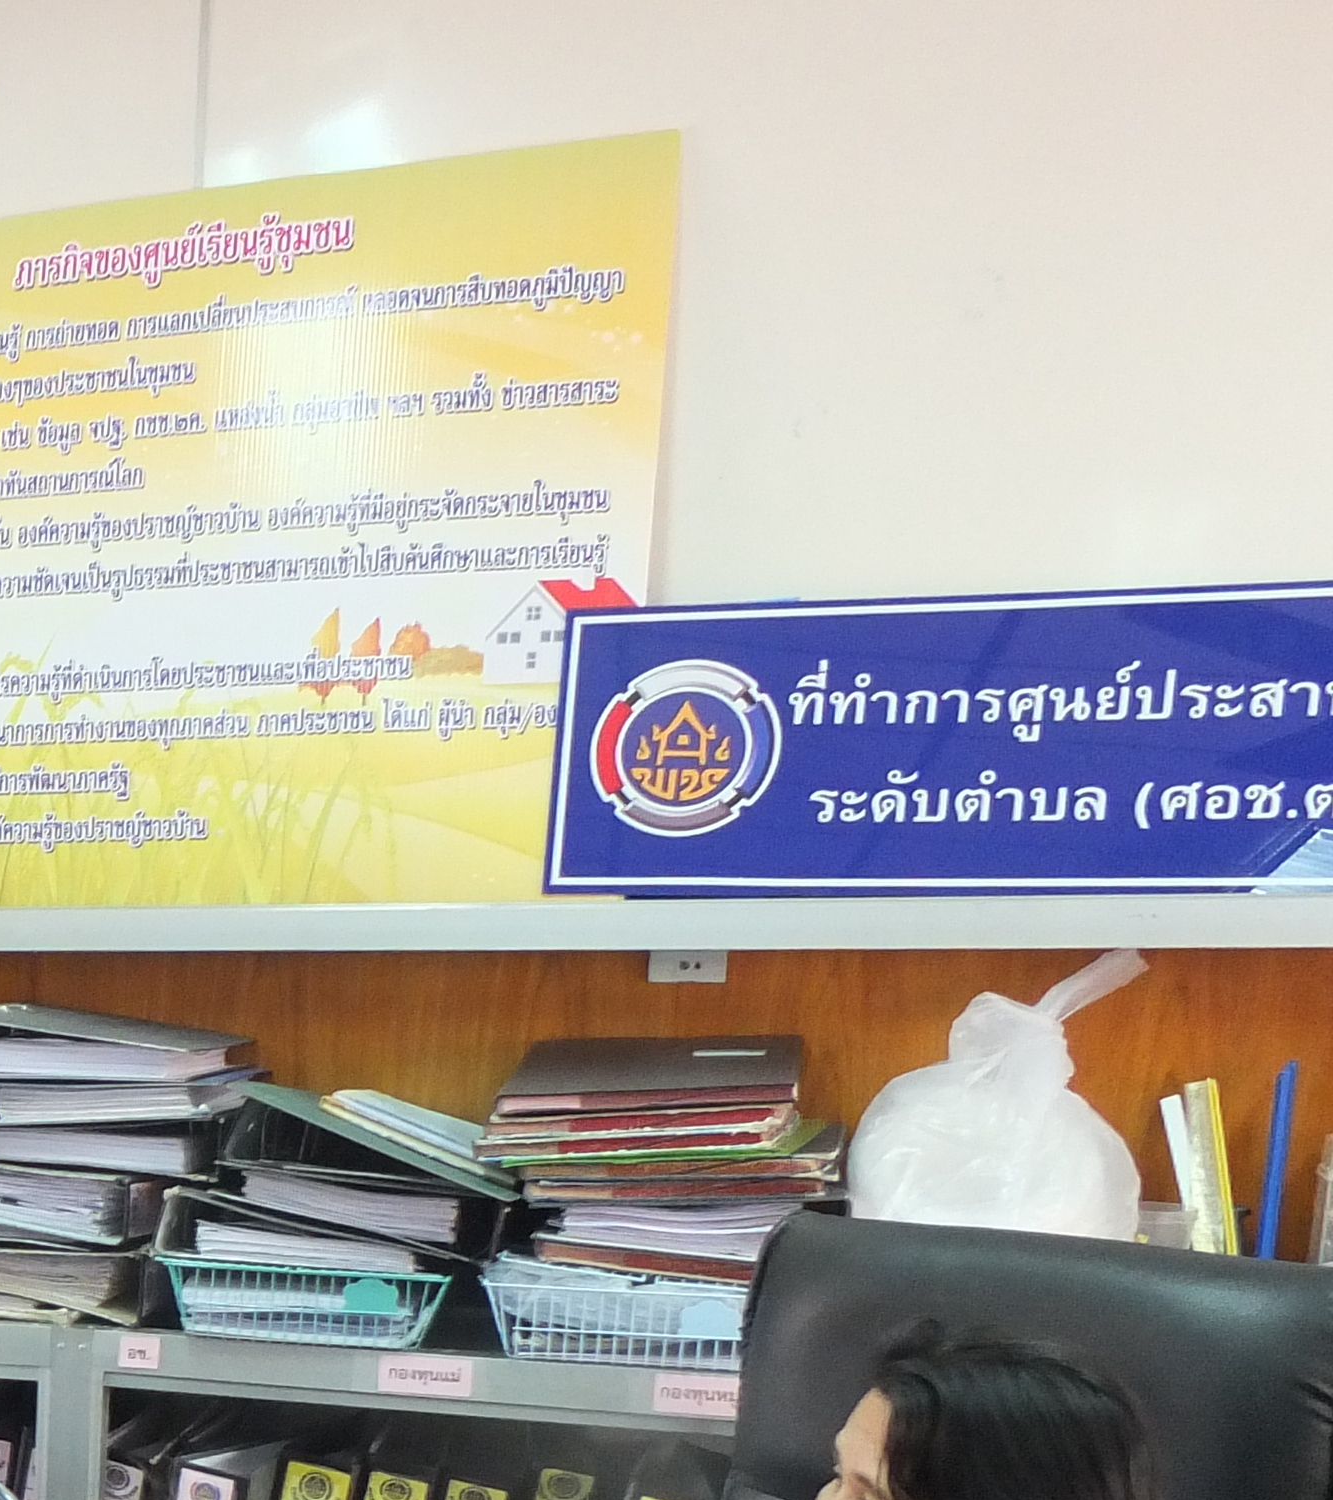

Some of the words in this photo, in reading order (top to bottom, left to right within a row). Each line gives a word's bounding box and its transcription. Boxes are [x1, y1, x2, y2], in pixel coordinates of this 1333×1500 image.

[13, 213, 355, 291] ภารกิจของศูนย์เรียนรู้ชุมชน
[25, 316, 120, 353] การถ่ายทอด
[0, 420, 31, 450] เช่น
[36, 419, 83, 455] ข้อมูล
[433, 373, 494, 415] รวมทั้ง
[501, 375, 621, 408] ข่าวสารสาระ
[18, 502, 261, 552] องค์ความรู้ของปราชญ์ชาวบ้าน
[256, 704, 375, 736] ภาคประชาชน
[383, 697, 432, 733] ได้แก่
[437, 699, 475, 741] ผู้นำ
[809, 769, 1108, 823] ระดับตำบล
